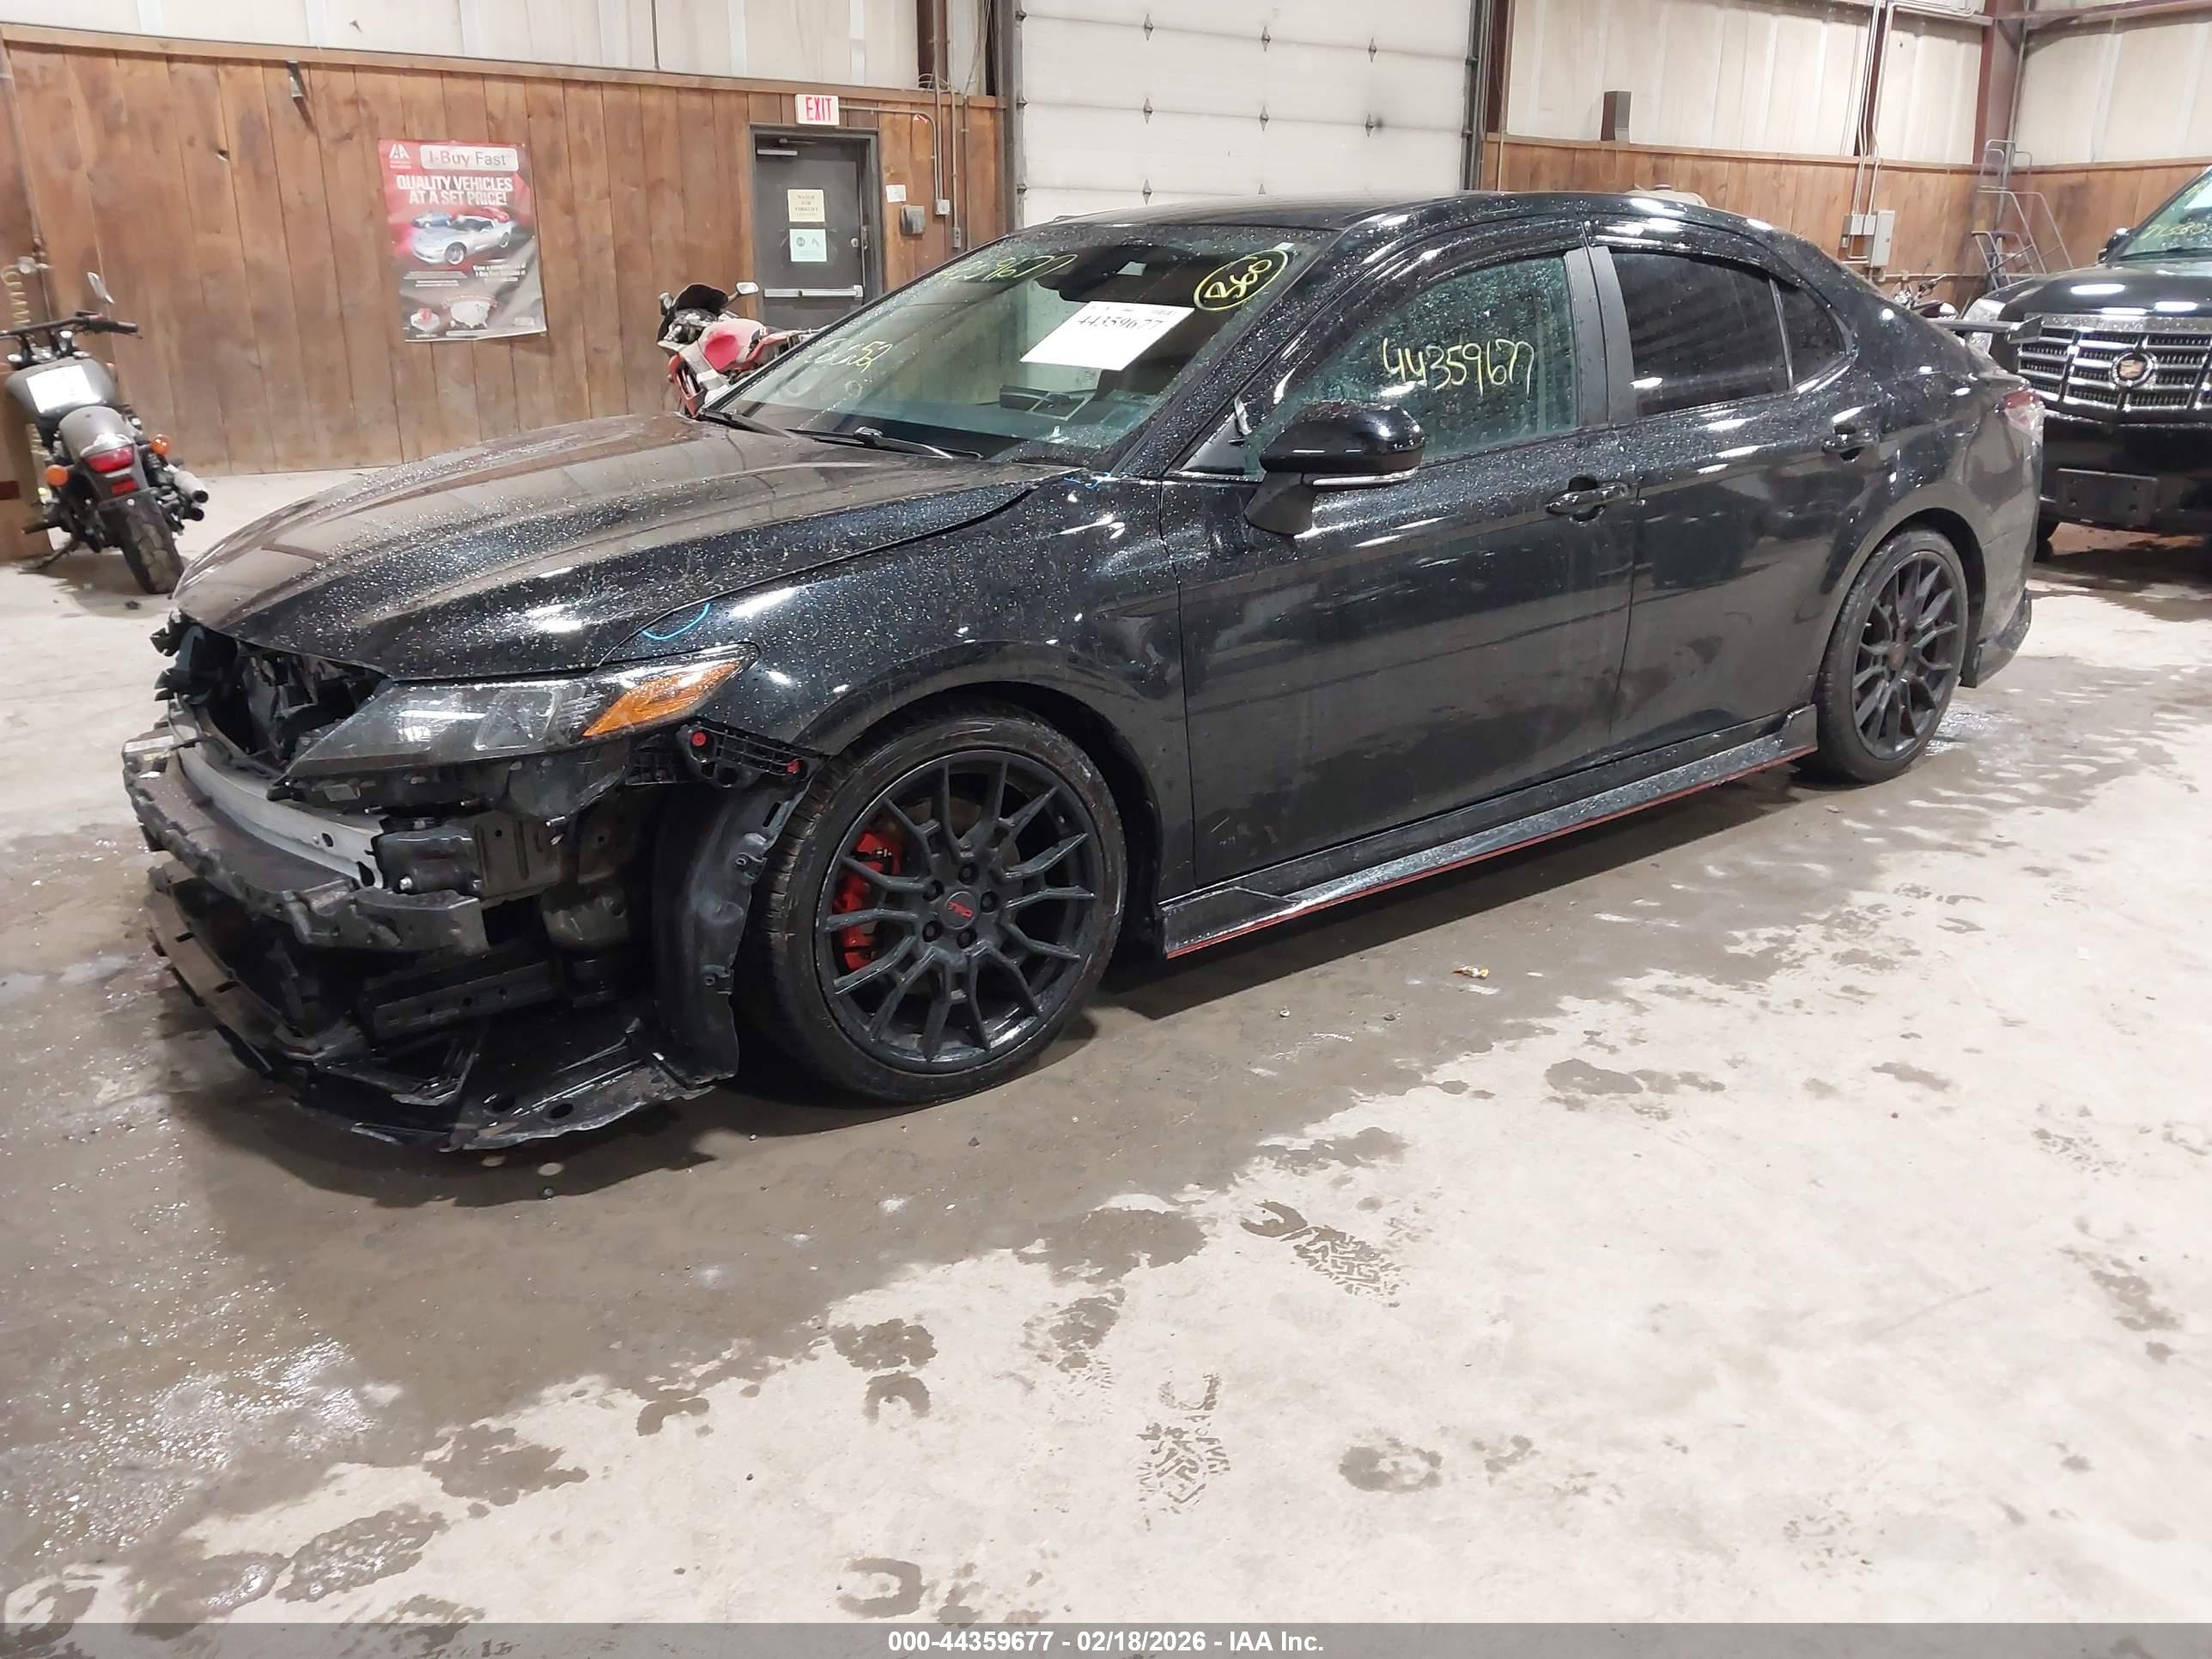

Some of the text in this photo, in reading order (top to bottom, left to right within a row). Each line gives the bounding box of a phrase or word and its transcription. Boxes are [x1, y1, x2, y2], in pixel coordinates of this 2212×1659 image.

[805, 96, 831, 121] EXIT
[428, 149, 471, 167] I-Buy
[475, 151, 507, 166] Fast
[396, 174, 514, 191] QUALITY VEHICLES
[409, 191, 507, 205] AT A SET PRICE!
[1382, 337, 1535, 398] 44359677
